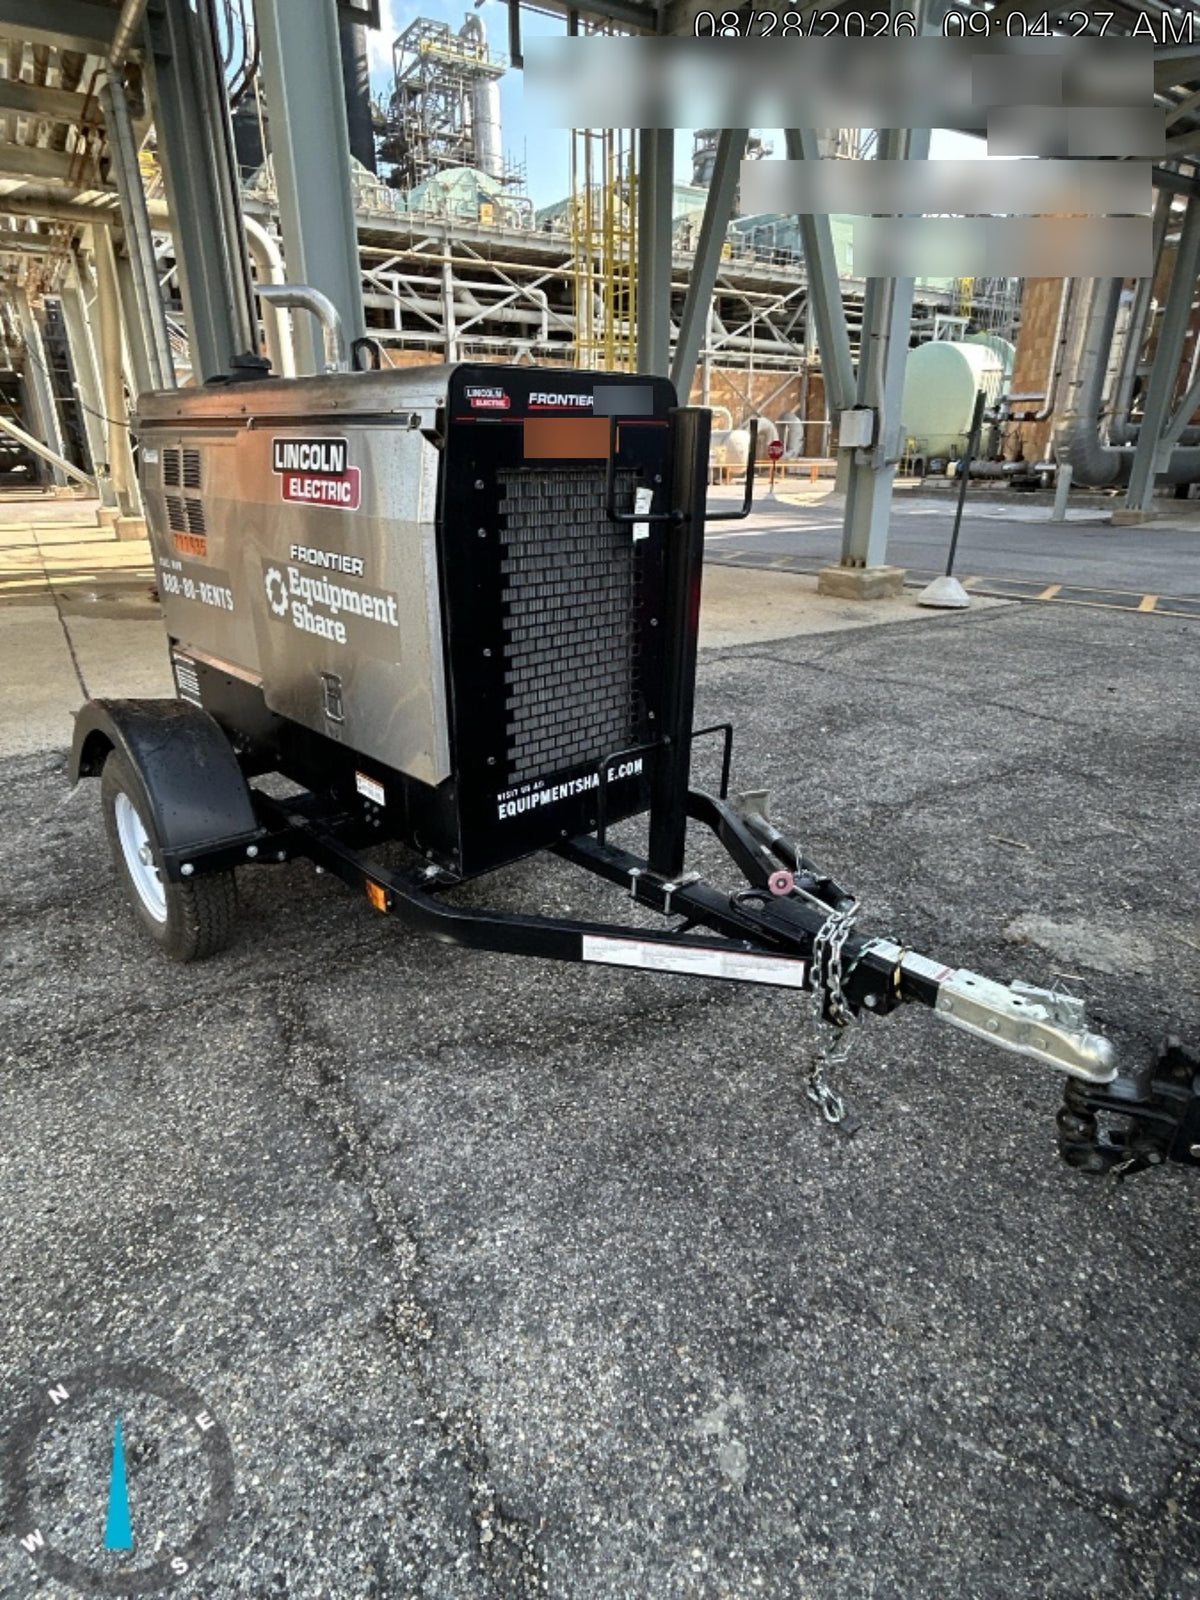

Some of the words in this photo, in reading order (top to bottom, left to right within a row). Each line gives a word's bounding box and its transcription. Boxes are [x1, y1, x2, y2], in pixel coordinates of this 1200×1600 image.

[467, 388, 503, 398] LINCOLN
[274, 443, 345, 472] LINCOLN
[289, 477, 351, 502] ELECTRIC
[289, 544, 364, 578] FRONTIER
[287, 566, 399, 626] Equipment
[291, 600, 348, 645] Share
[498, 757, 643, 820] EQUIPMENTSHAE.COM
